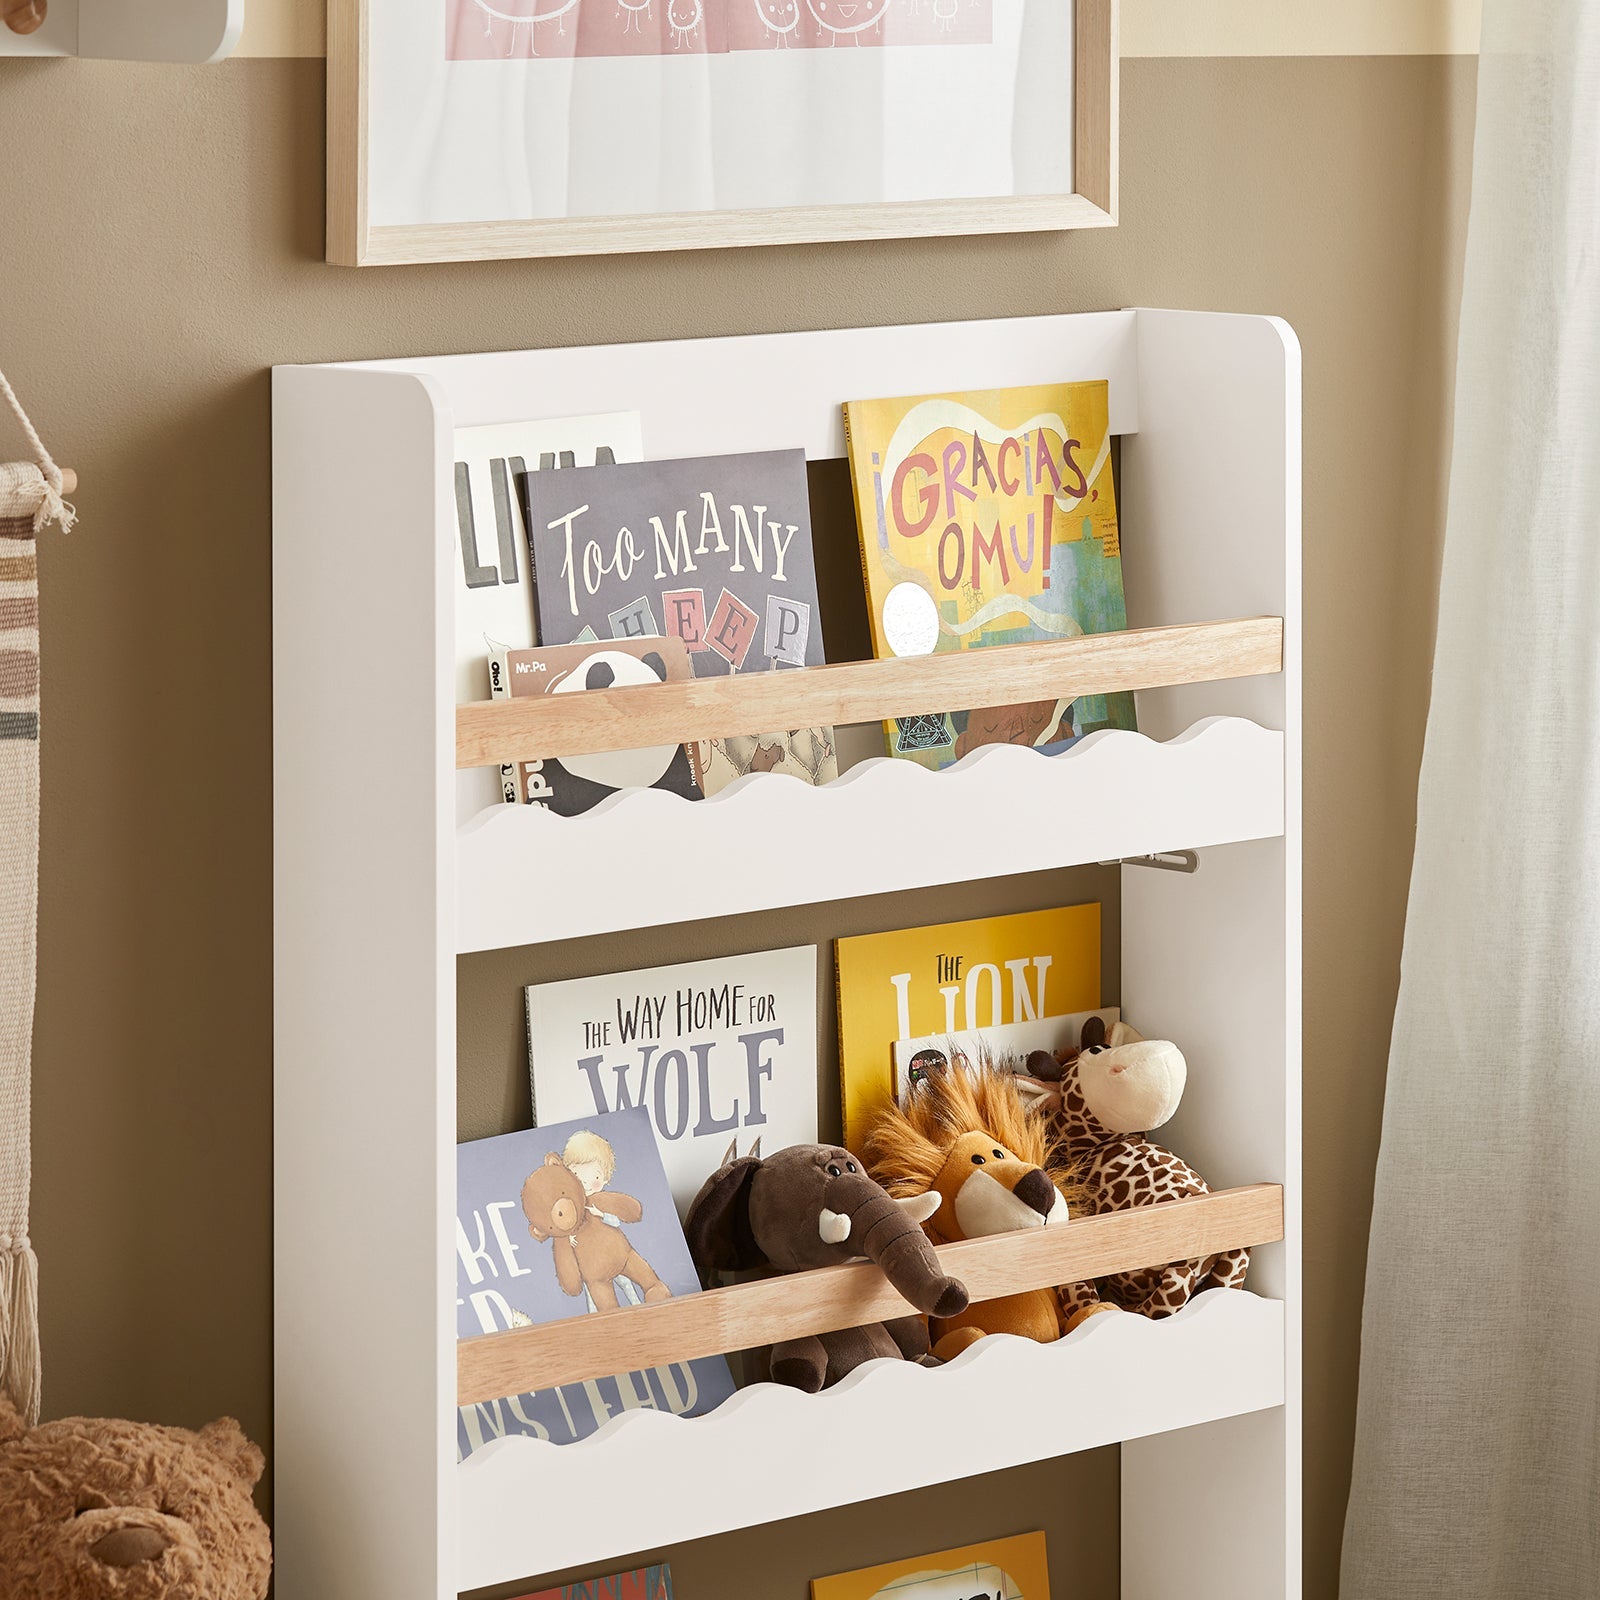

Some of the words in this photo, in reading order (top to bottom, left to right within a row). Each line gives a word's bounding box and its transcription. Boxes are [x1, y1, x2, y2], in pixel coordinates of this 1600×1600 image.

[648, 491, 799, 582] MANY
[938, 494, 1054, 591] OMU!
[936, 953, 964, 984] THE
[582, 1020, 611, 1050] THE
[616, 995, 666, 1044] WAY
[676, 984, 745, 1037] HOME
[749, 994, 776, 1025] FOR
[577, 1027, 785, 1141] WOLF
